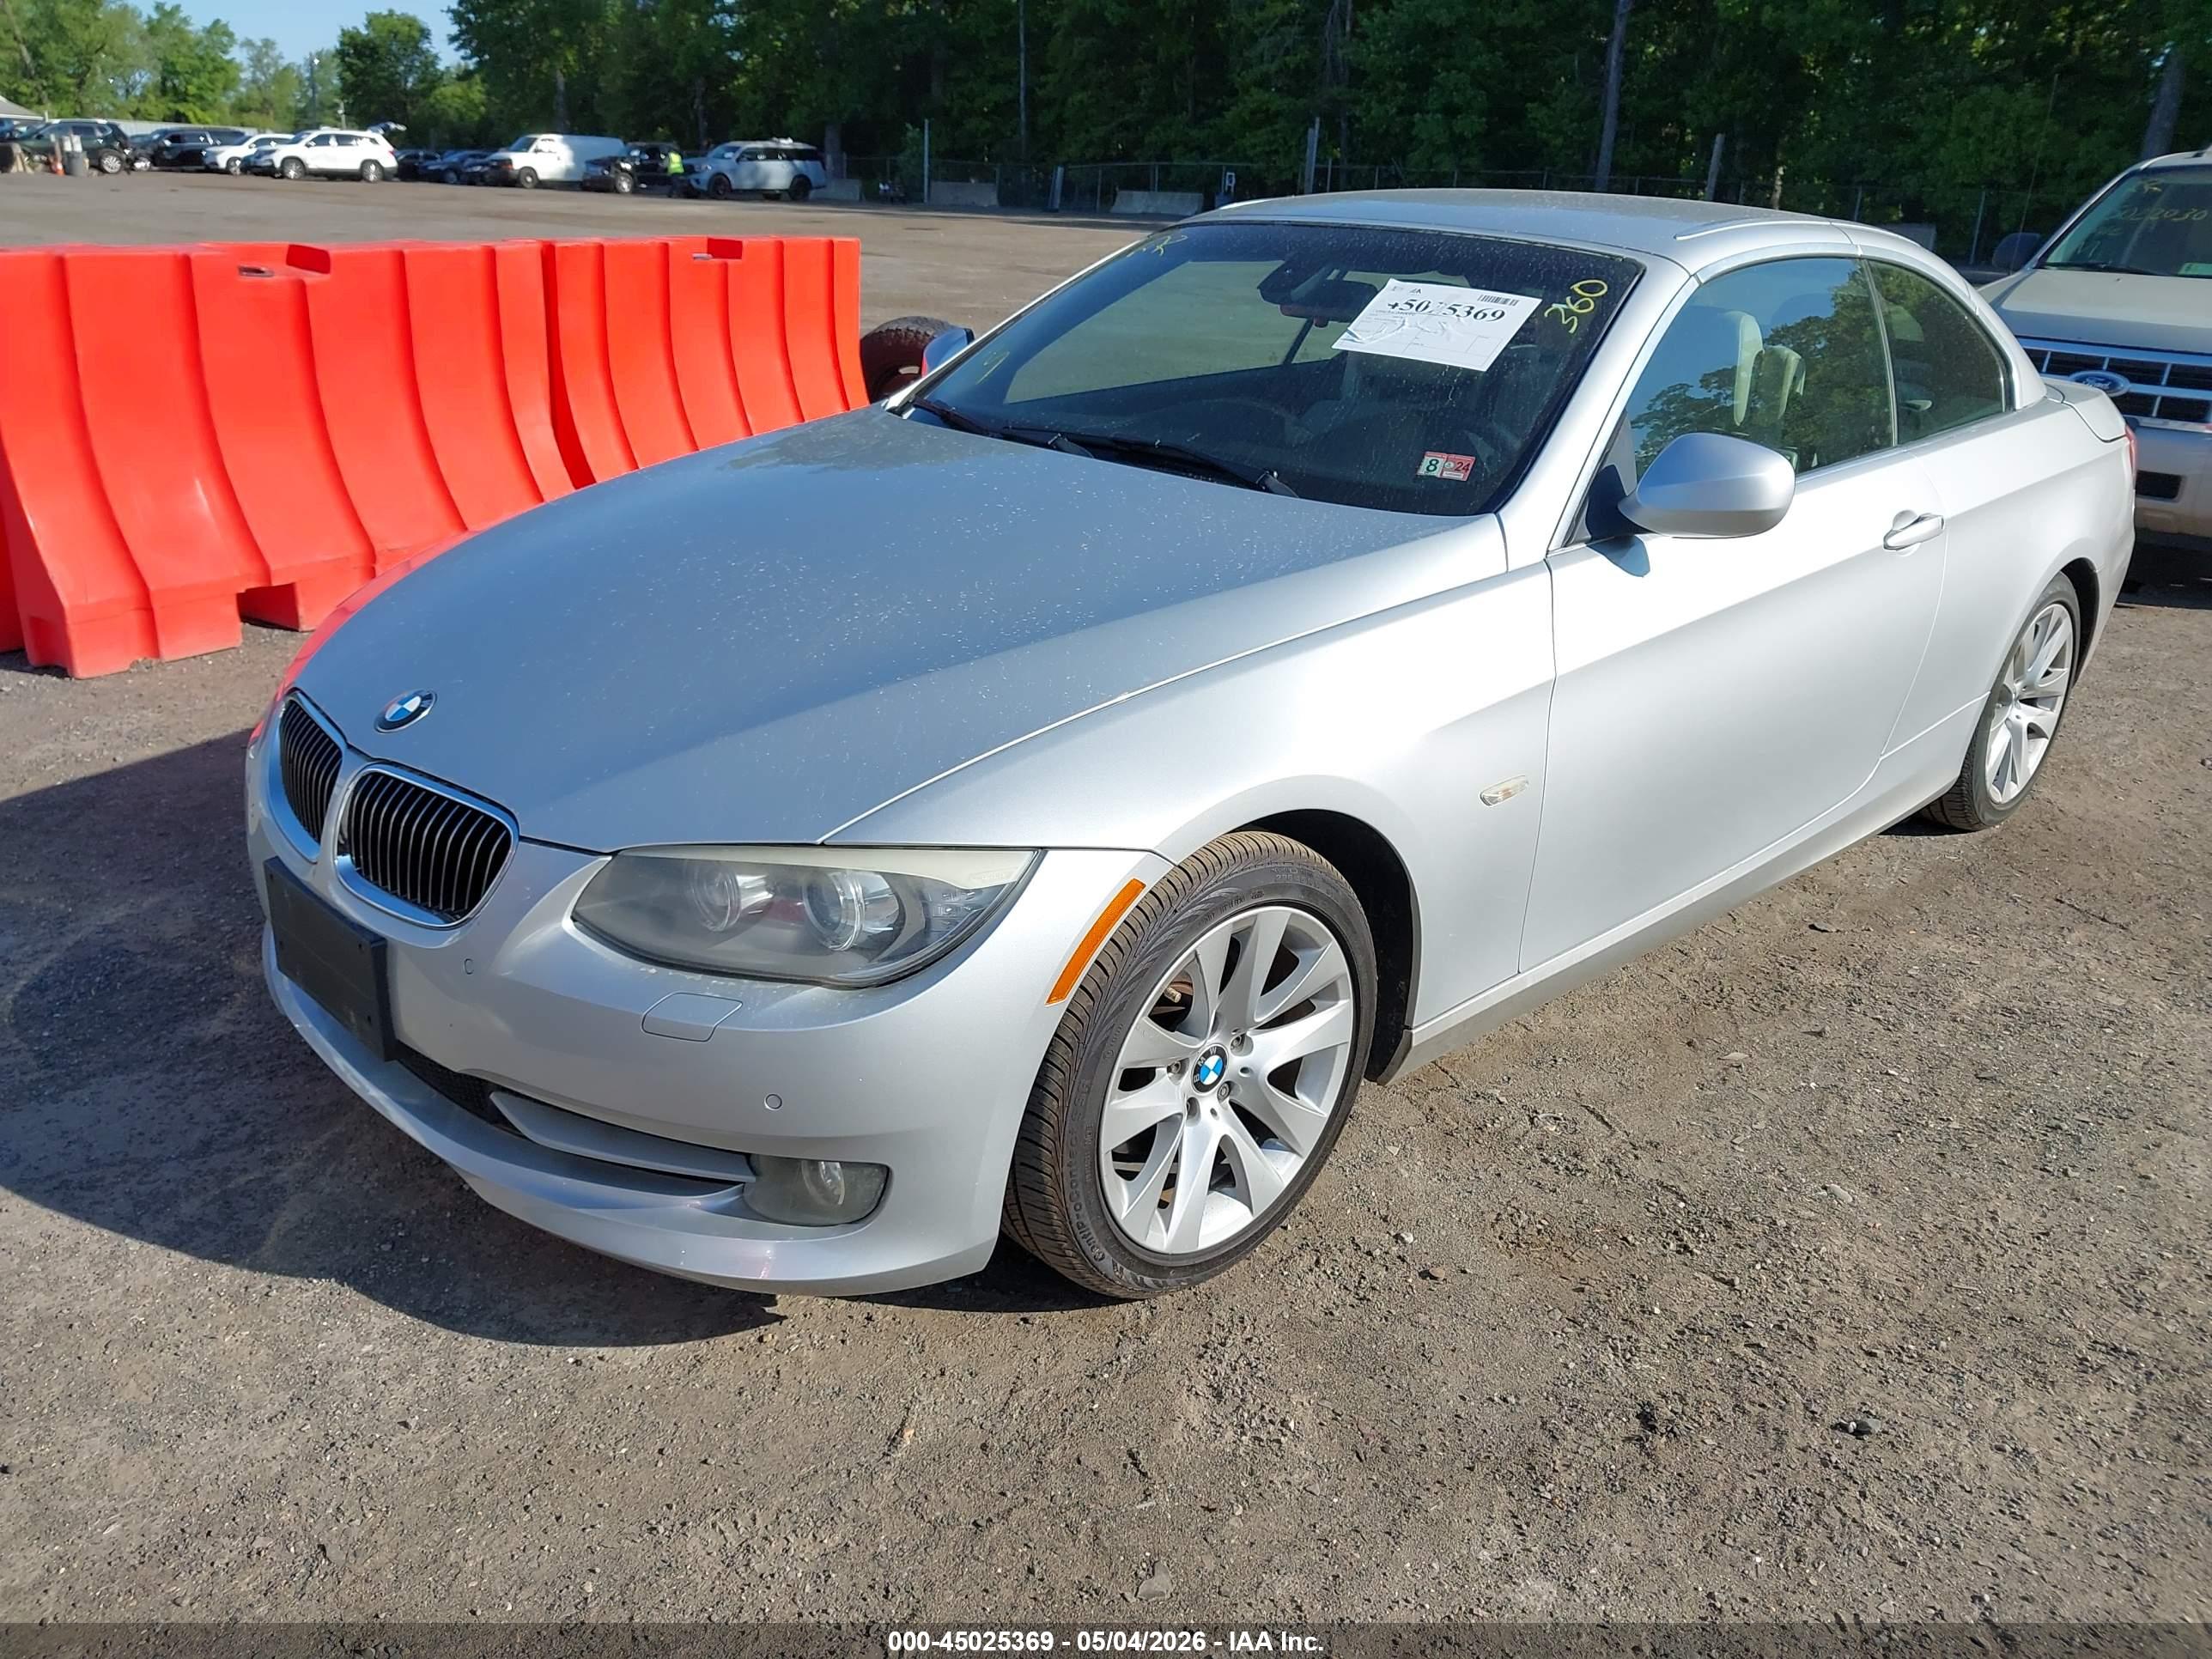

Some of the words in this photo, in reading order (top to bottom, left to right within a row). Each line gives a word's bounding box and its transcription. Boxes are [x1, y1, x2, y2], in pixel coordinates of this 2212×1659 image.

[1544, 279, 1608, 334] 360
[1425, 459, 1440, 472] 8
[1454, 461, 1471, 473] 24
[1193, 1046, 1218, 1084] BMW
